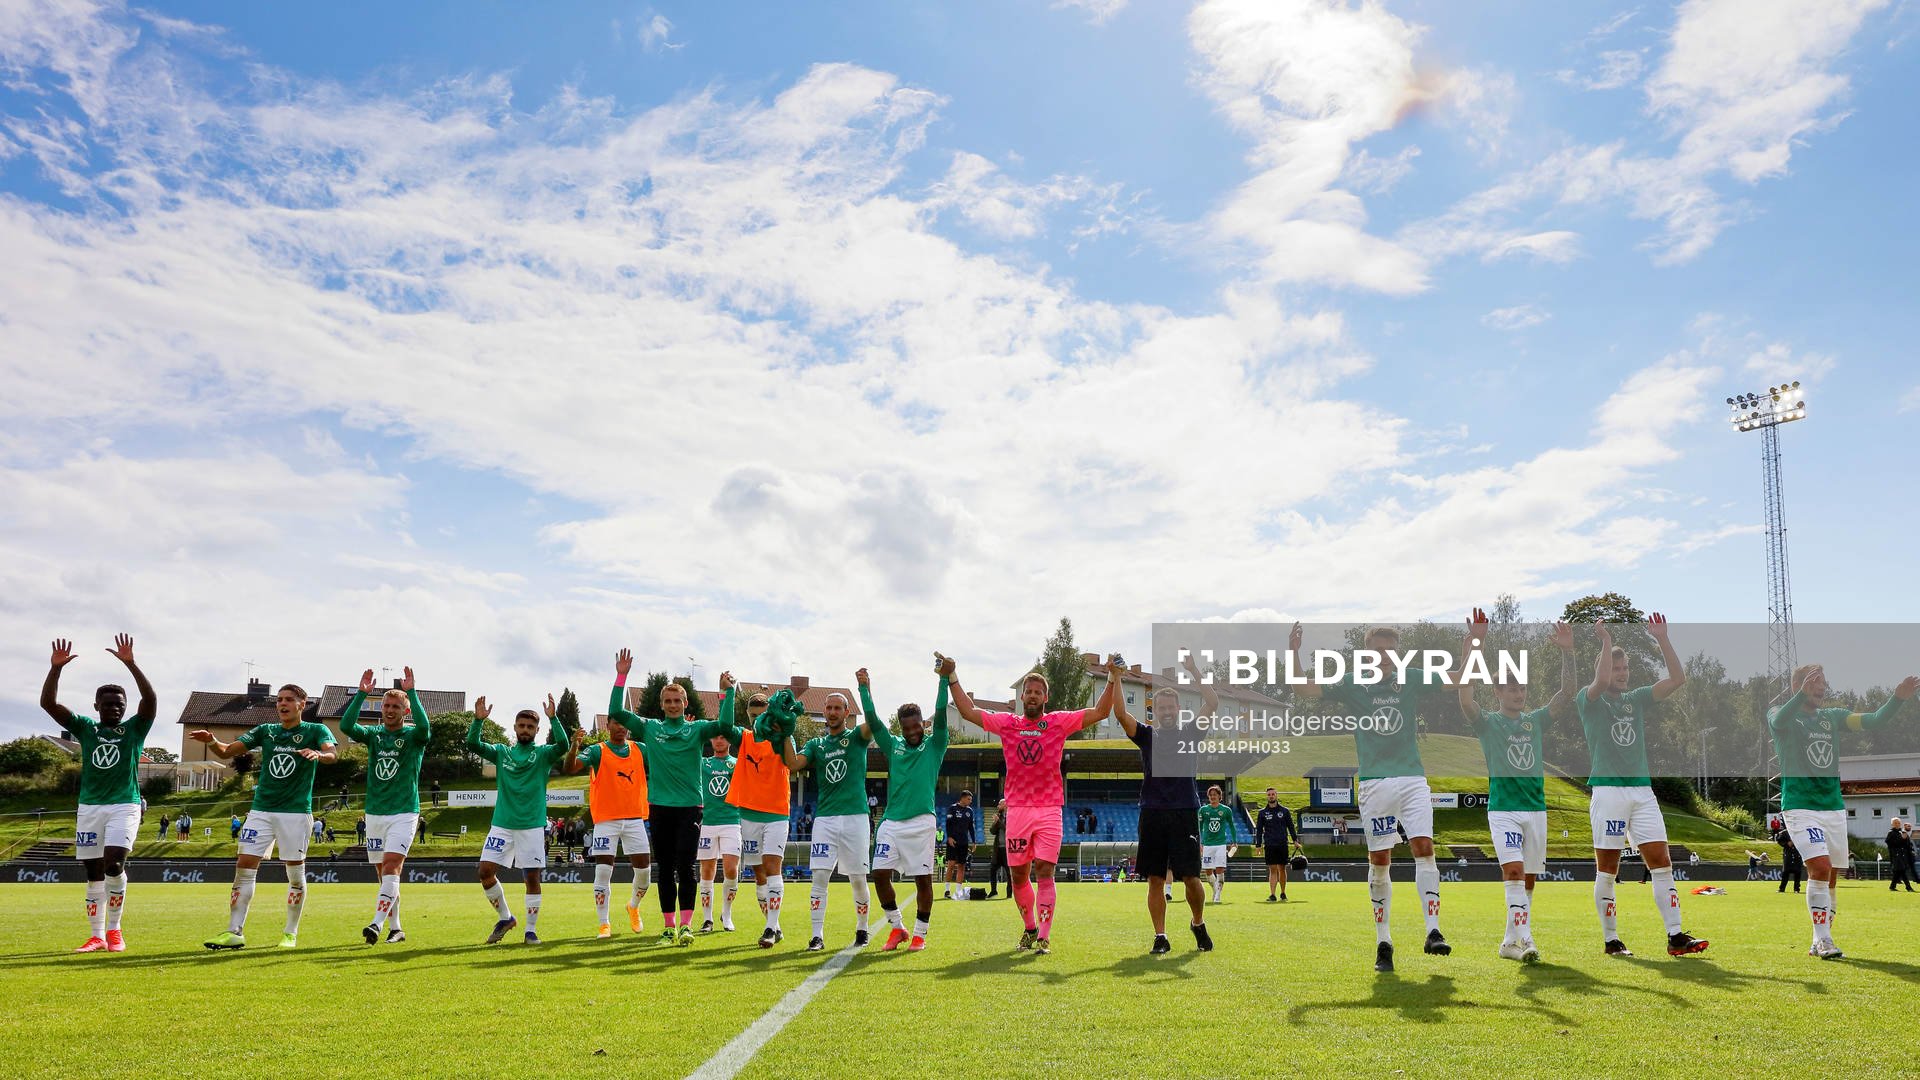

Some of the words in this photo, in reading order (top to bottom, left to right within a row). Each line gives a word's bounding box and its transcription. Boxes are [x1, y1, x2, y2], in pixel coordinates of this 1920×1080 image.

[1371, 816, 1396, 831] NP
[1606, 820, 1625, 832] NP
[76, 832, 97, 843] NP
[367, 838, 382, 849] NP
[485, 836, 505, 849] NP
[594, 837, 610, 847] NP
[1008, 838, 1027, 849] NP
[812, 843, 829, 854] NP
[17, 868, 60, 882] toxic
[162, 868, 204, 882] toxic
[305, 869, 340, 882] oxic
[409, 869, 450, 883] toxic
[541, 869, 582, 883] toxic
[1304, 868, 1343, 882] toxic
[1441, 869, 1462, 881] xic
